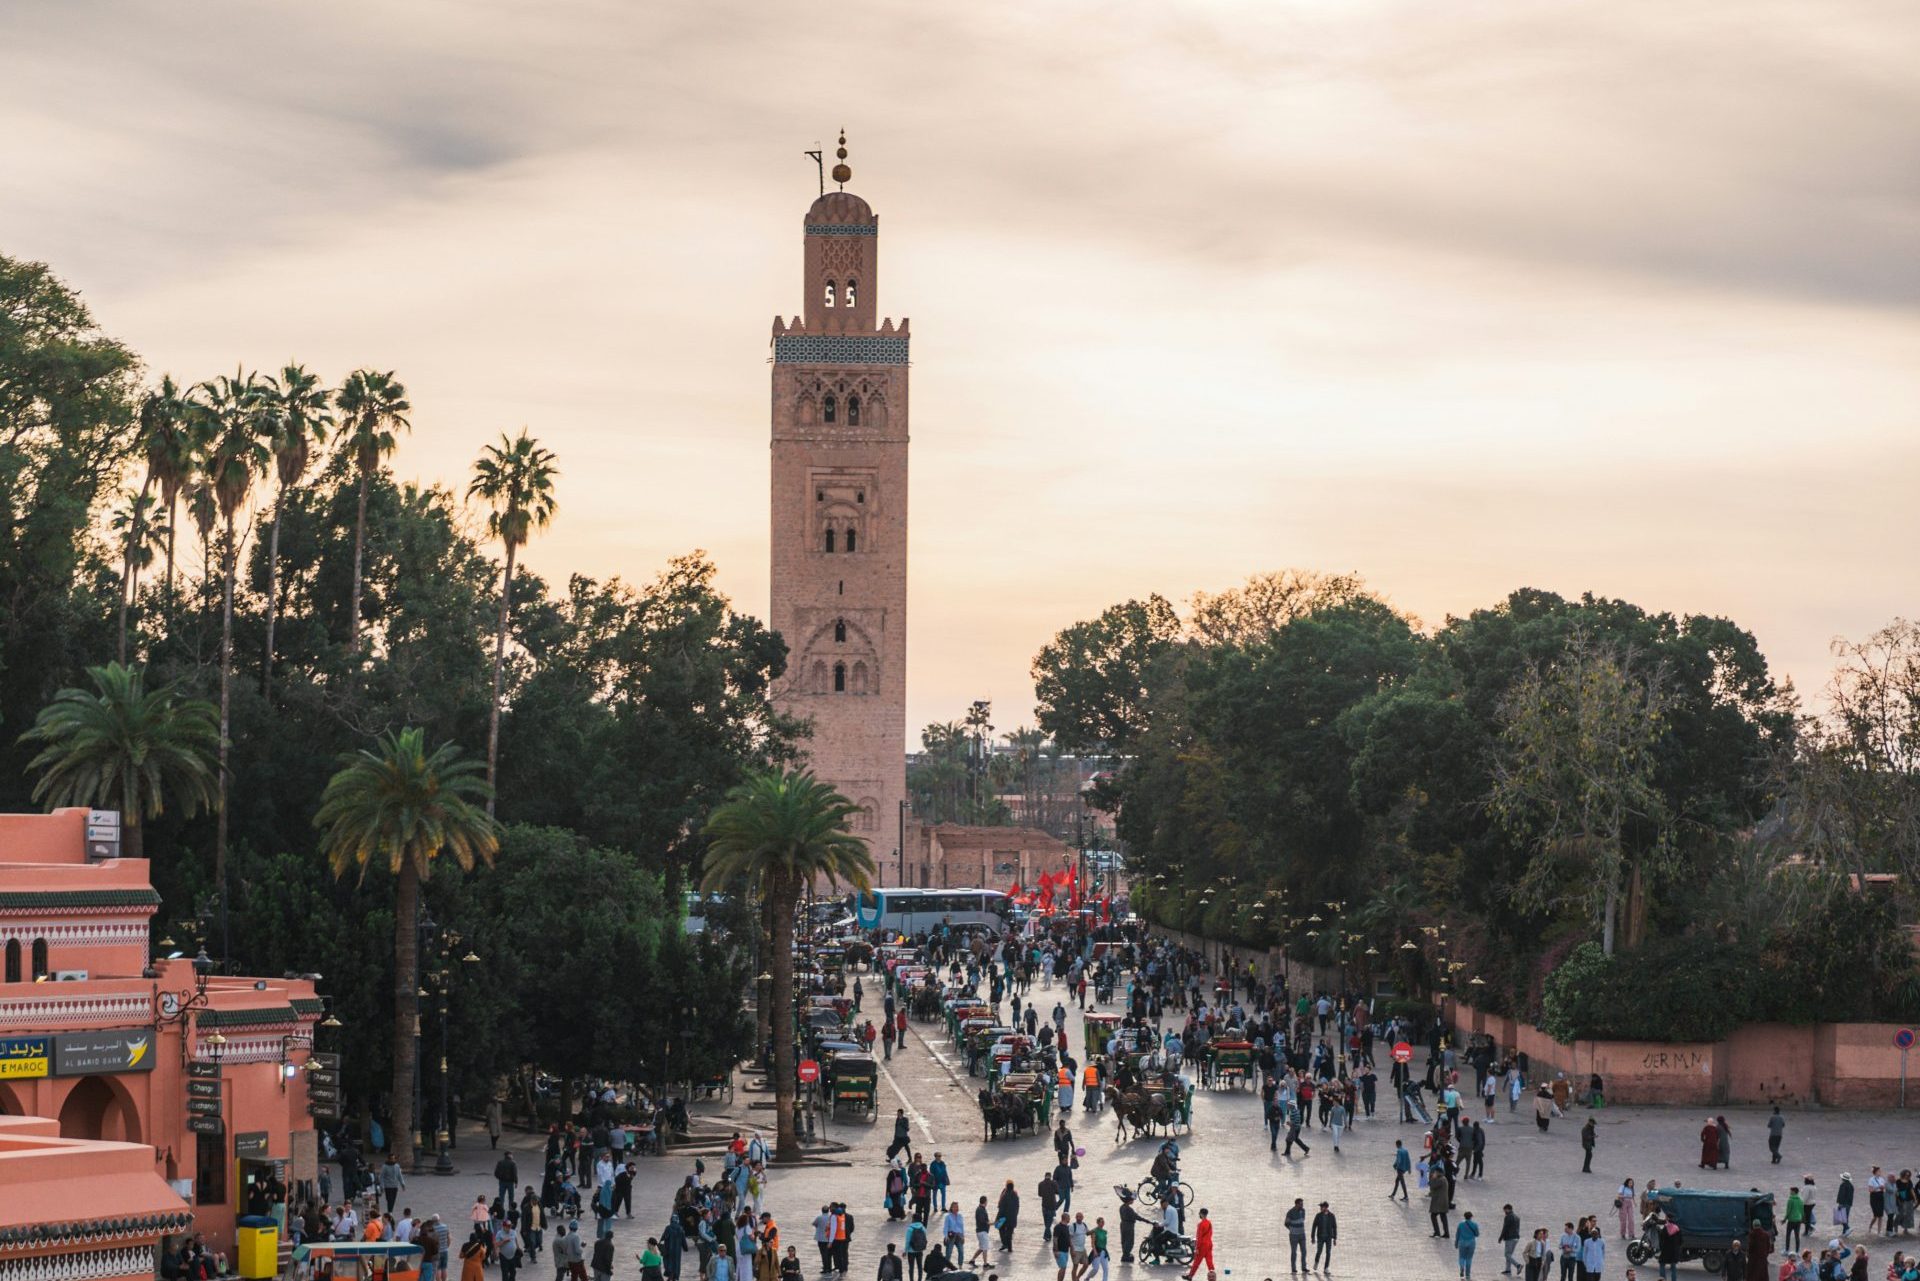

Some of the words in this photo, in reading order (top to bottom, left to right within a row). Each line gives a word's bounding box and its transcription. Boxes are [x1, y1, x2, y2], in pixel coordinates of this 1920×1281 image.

[10, 1042, 44, 1057] بريد
[10, 1062, 44, 1072] MAROC
[65, 1059, 74, 1067] AL
[77, 1058, 100, 1067] BARID
[102, 1057, 122, 1065] BANK
[193, 1121, 215, 1129] Cambio
